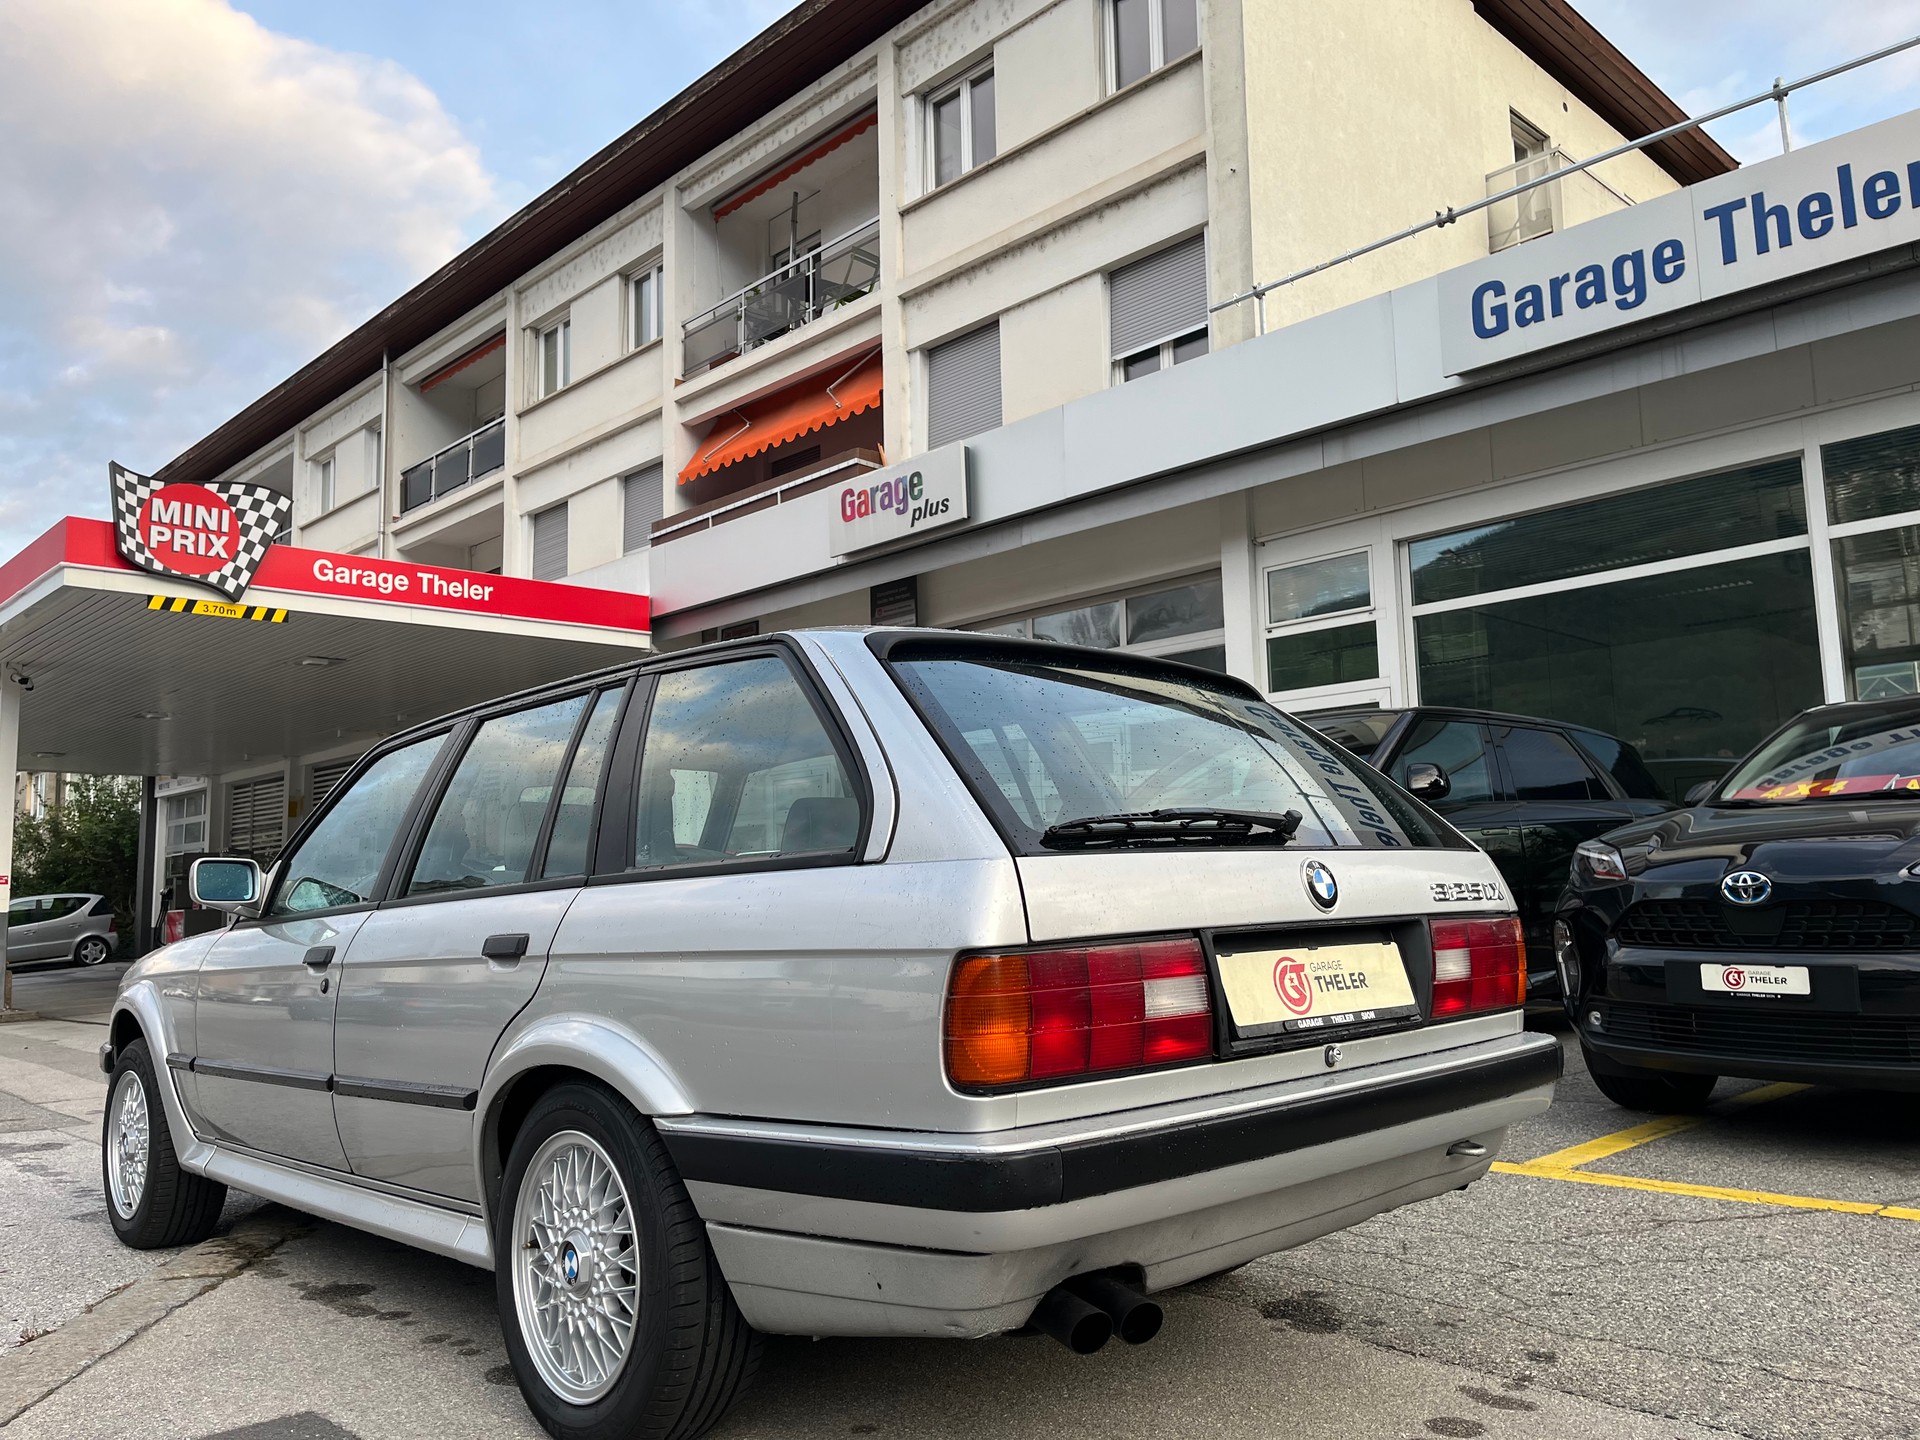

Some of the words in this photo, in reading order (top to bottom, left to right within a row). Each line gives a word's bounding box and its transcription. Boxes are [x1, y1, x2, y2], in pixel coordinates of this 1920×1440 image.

[1471, 237, 1686, 341] Garage
[840, 470, 924, 523] Garage
[910, 497, 950, 528] plus
[150, 497, 231, 534] MINI
[149, 524, 231, 560] PRIX
[312, 558, 410, 595] Garage
[416, 571, 494, 602] Theler
[1309, 960, 1343, 972] GARAGE
[1314, 971, 1369, 993] THELER
[1749, 976, 1788, 985] THELER
[1297, 1017, 1324, 1029] GARAGE
[1330, 1013, 1355, 1024] THELER
[1360, 1010, 1376, 1020] SION
